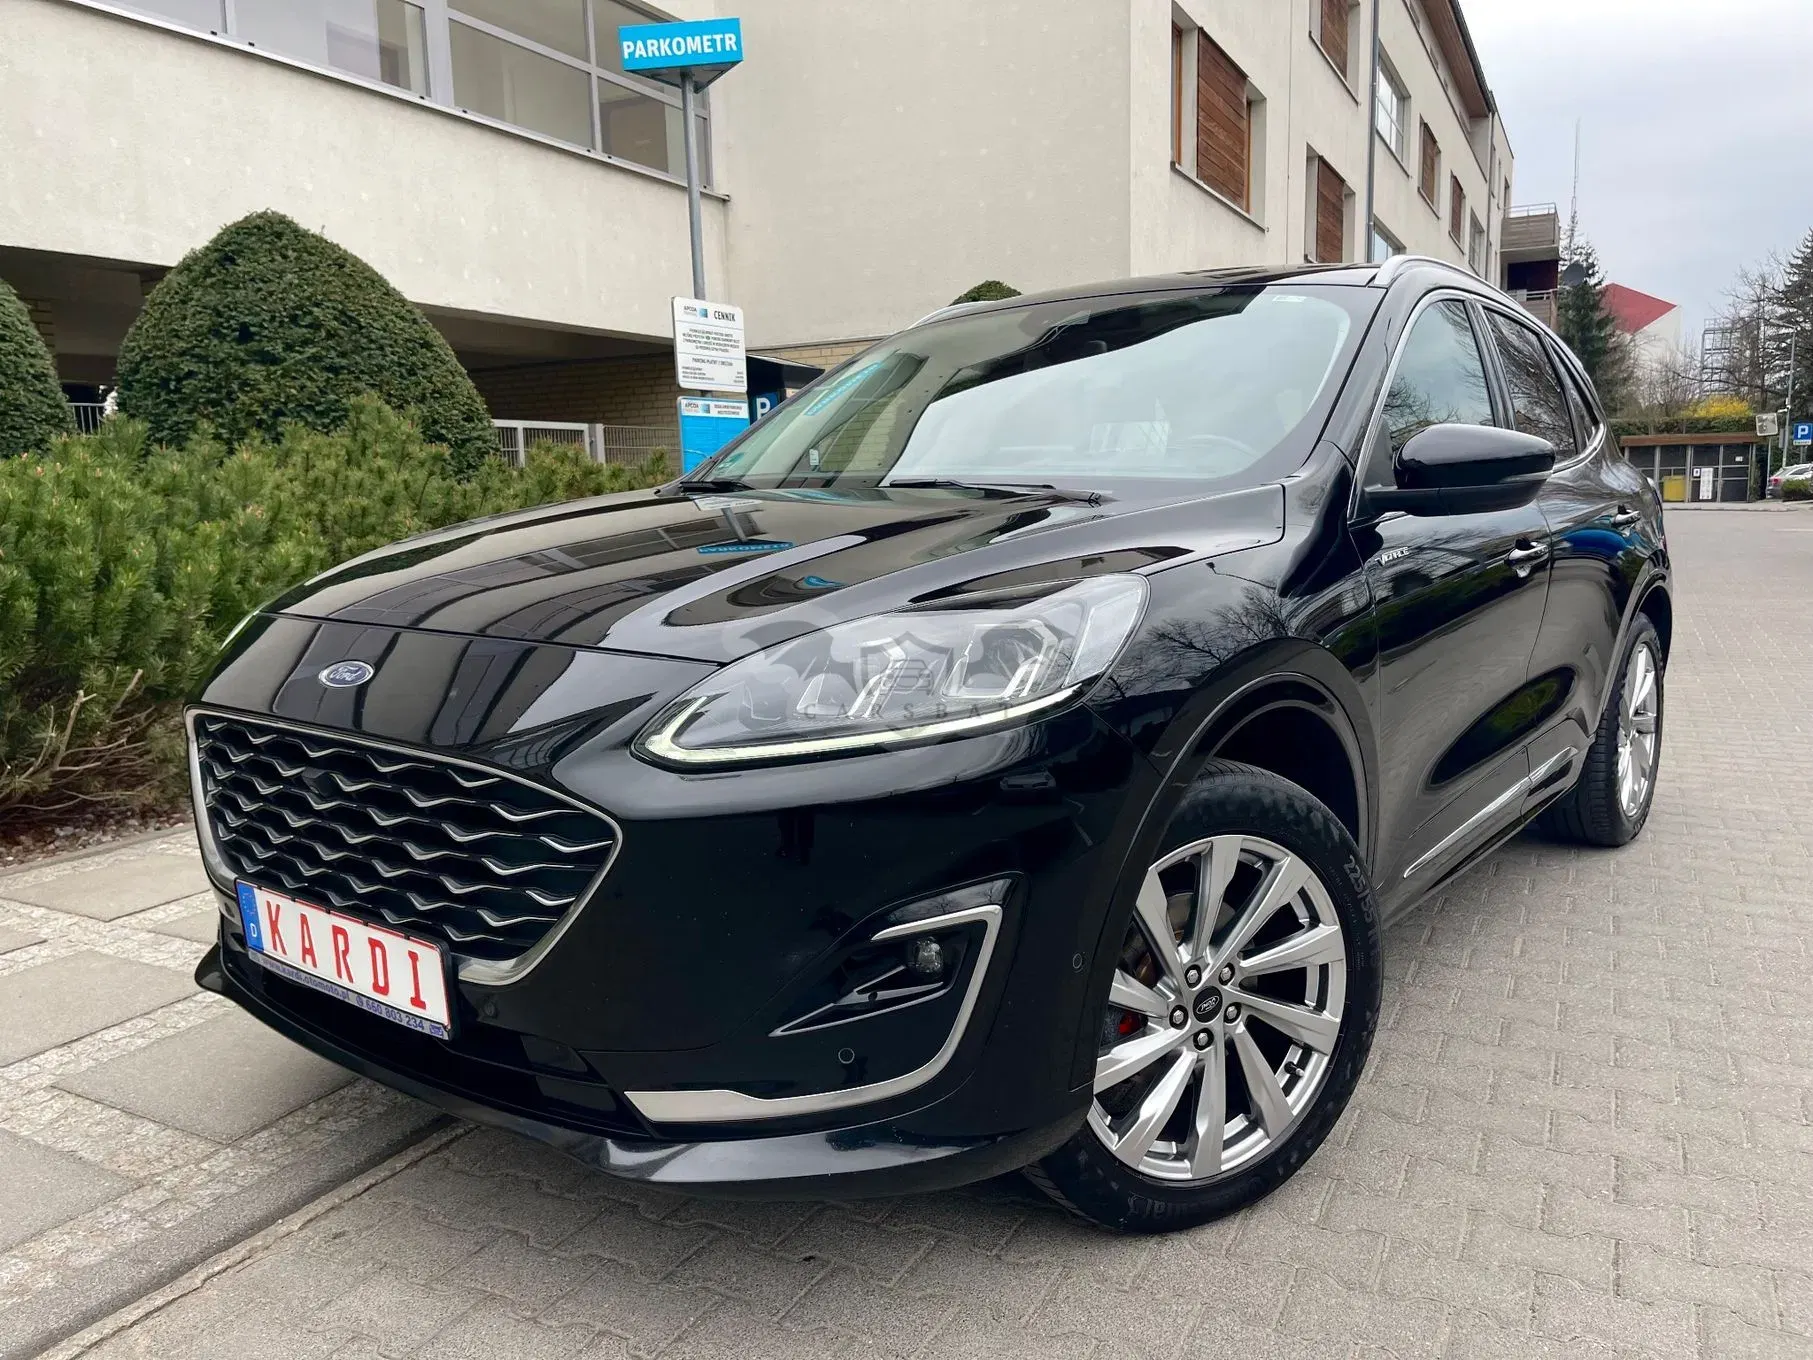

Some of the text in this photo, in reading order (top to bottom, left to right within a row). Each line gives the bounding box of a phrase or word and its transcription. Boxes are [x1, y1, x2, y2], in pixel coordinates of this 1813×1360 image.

[622, 33, 738, 59] PARKOMETR
[713, 310, 736, 321] CENNIK
[756, 397, 771, 420] P
[1797, 425, 1809, 438] P
[250, 922, 257, 938] D
[266, 900, 426, 1010] KARDI
[365, 999, 383, 1015] 660
[385, 1007, 403, 1023] 803
[405, 1015, 425, 1031] 234
